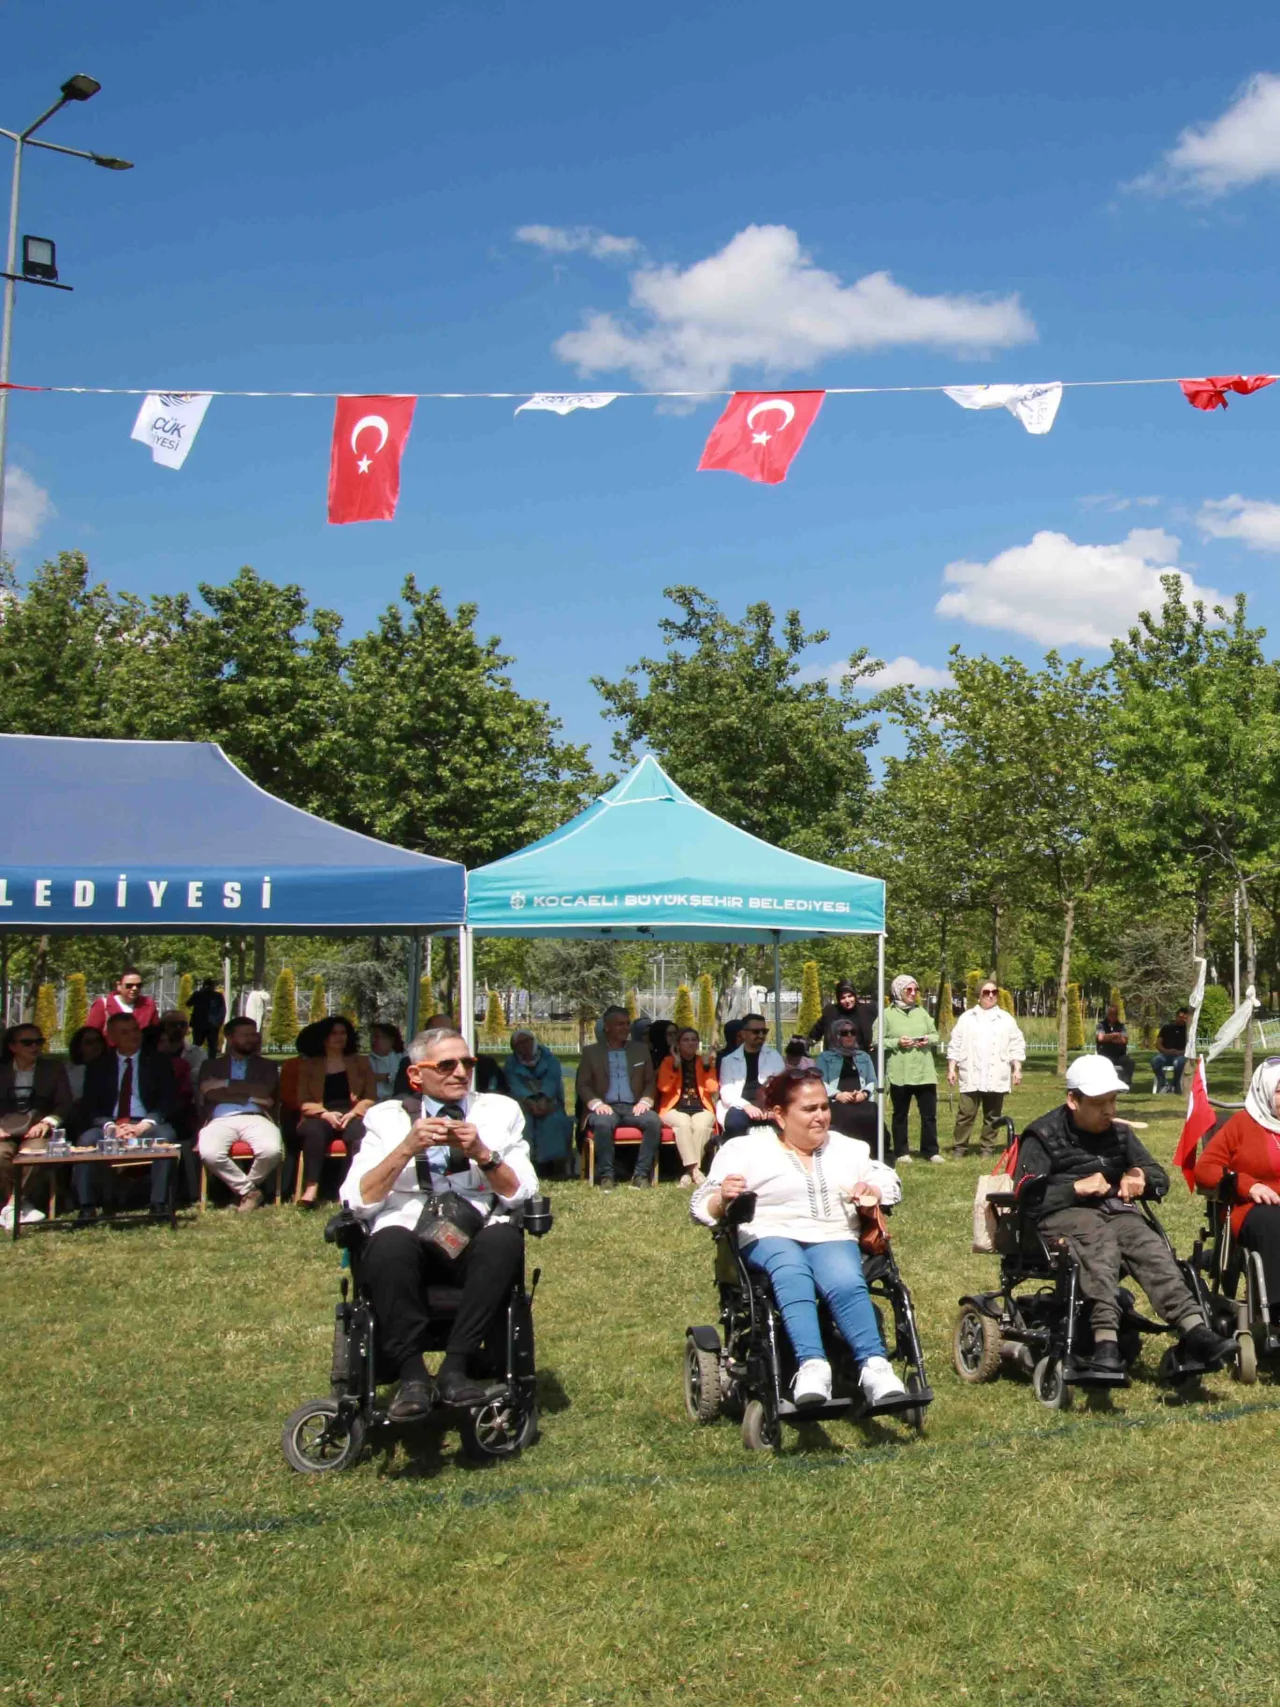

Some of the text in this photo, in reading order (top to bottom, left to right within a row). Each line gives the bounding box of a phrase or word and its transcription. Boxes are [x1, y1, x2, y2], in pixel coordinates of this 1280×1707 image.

[533, 894, 850, 913] KOCAELİ BÜYÜKŞEHİR BELEDİYESİ
